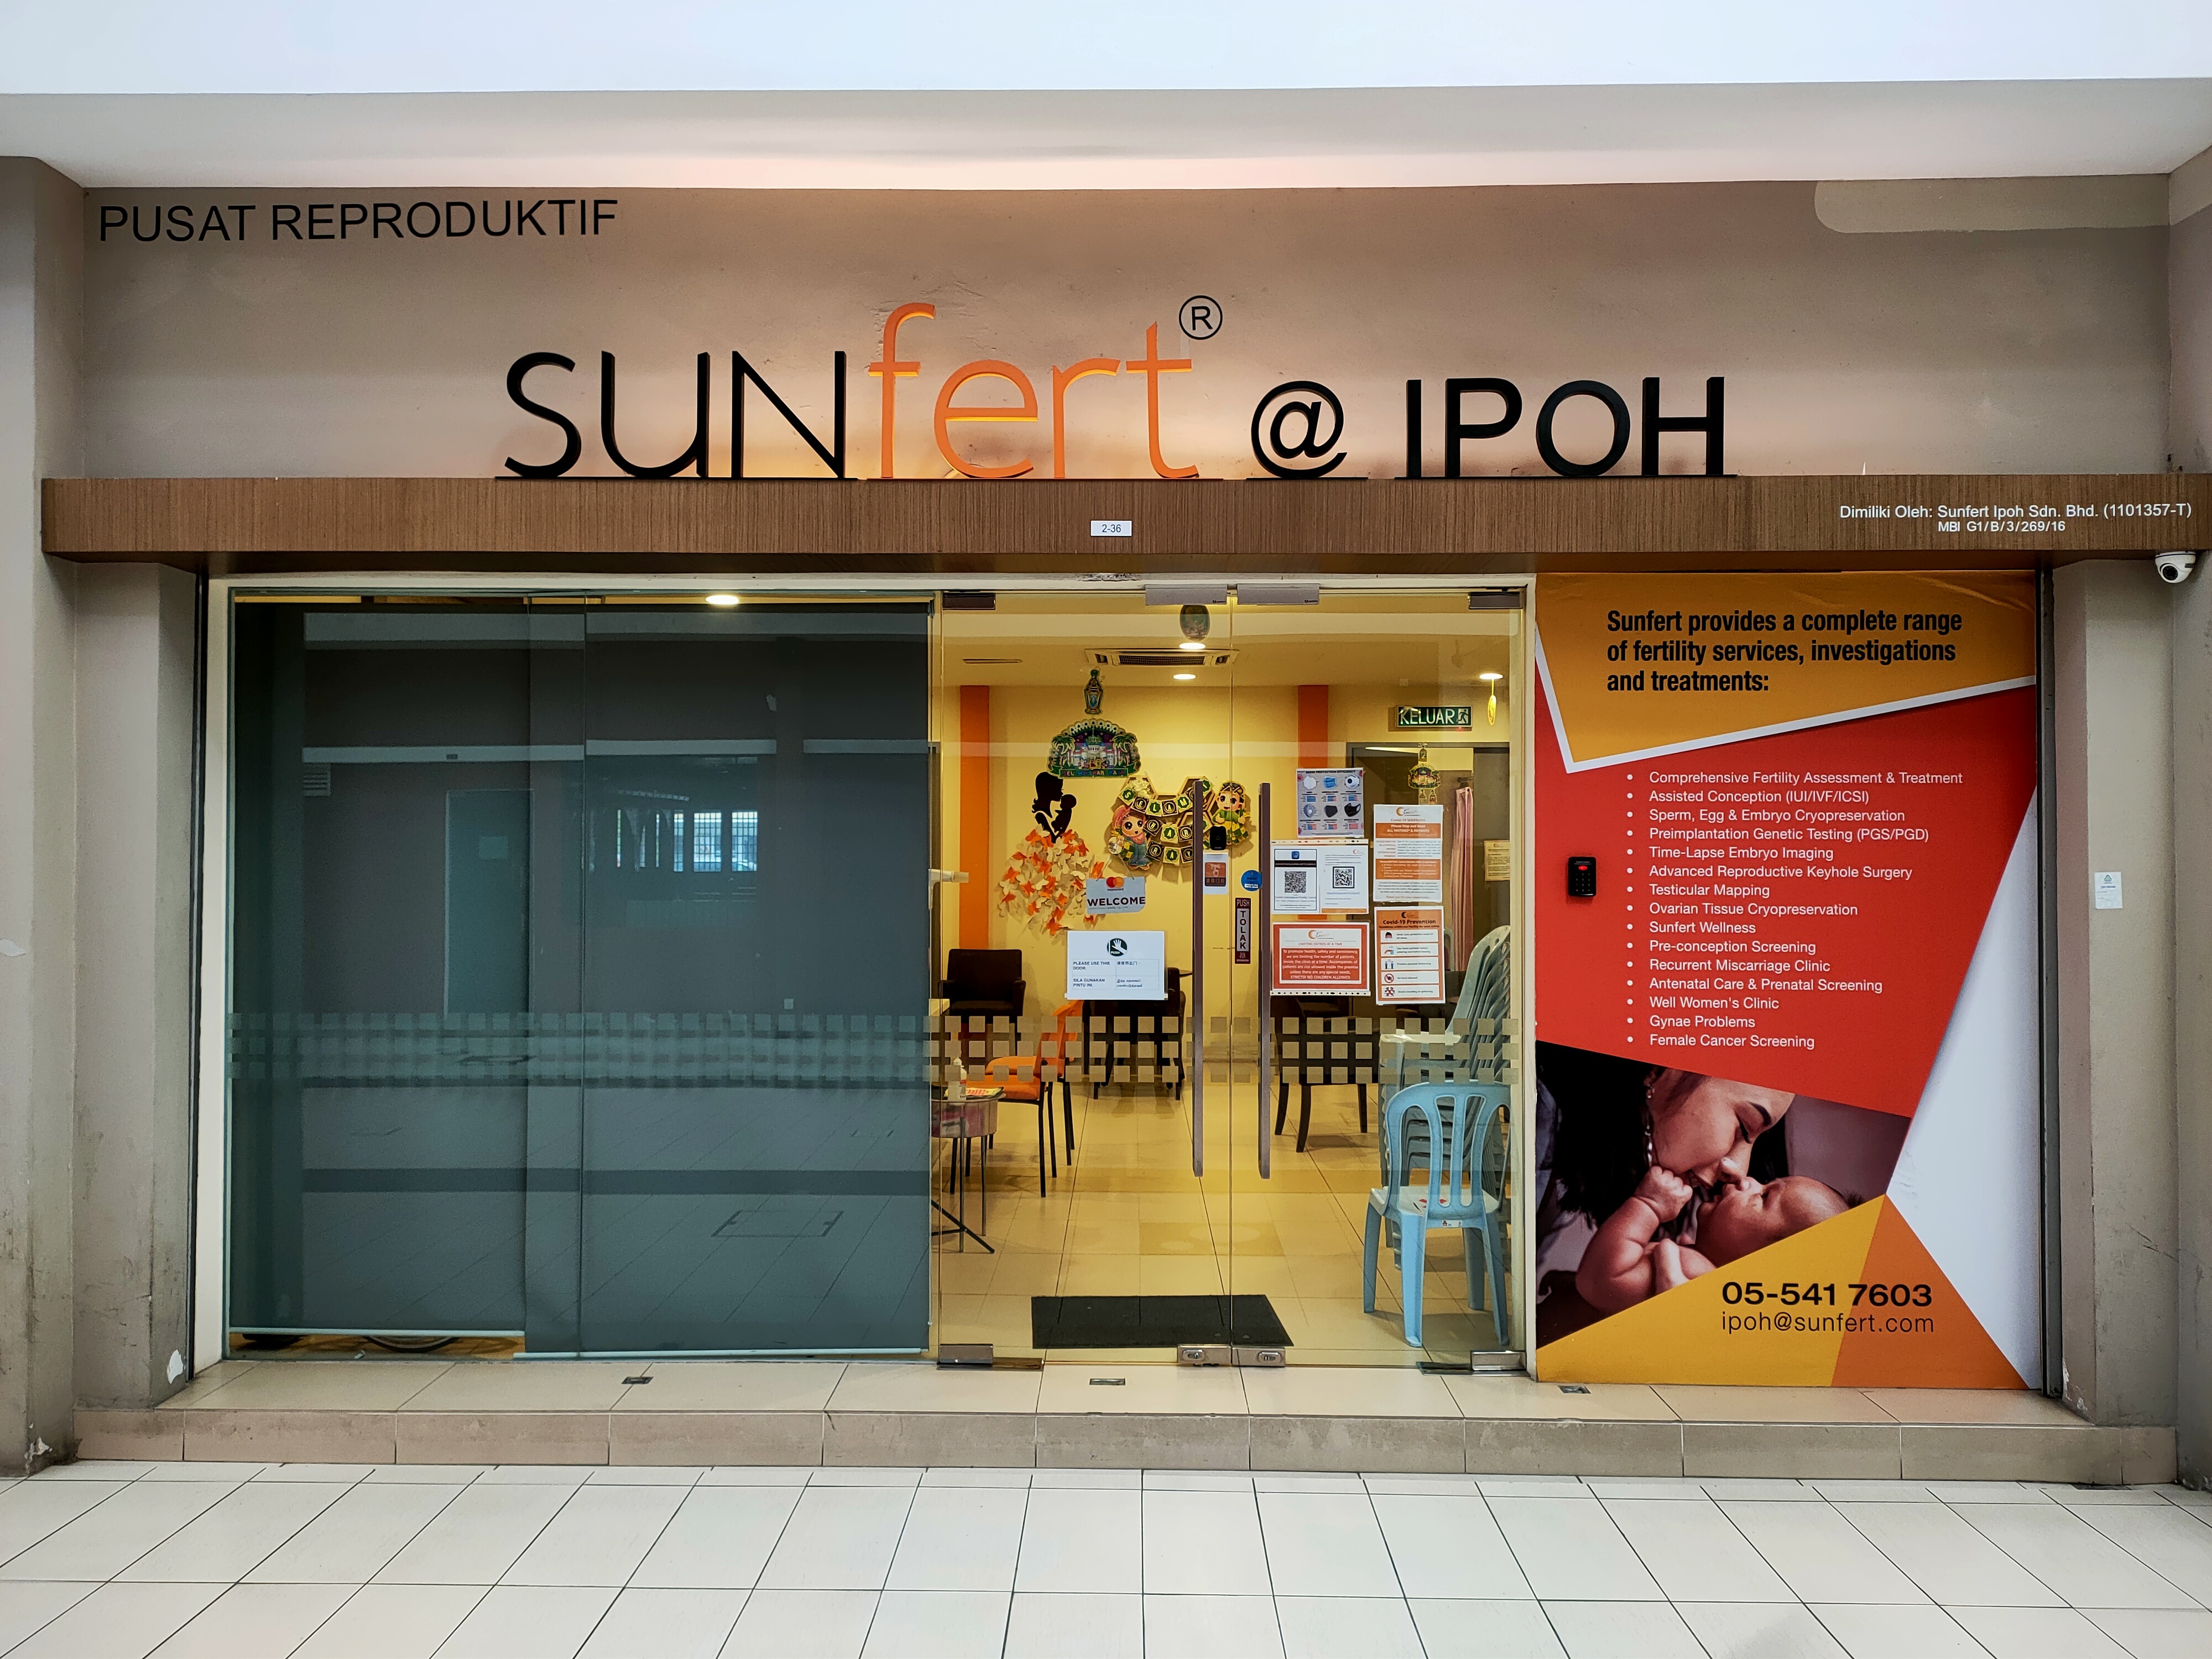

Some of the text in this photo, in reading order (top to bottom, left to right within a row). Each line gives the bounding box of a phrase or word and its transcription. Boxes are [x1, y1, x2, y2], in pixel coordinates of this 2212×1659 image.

[95, 199, 618, 242] PUSAT REPRODUKTIF
[504, 302, 1200, 478] SUNfert
[1251, 380, 1348, 478] @
[1406, 376, 1725, 477] IPOH
[1840, 502, 2192, 520] Dimiliki Oleh: Sunfert Ipoh Sdn. Bhd. (1101357-T)
[1102, 524, 1121, 533] 2-36
[1938, 520, 2065, 532] MBI G1/B/3/269/16
[1607, 609, 1963, 636] Sunfert provides a complete range
[1607, 639, 1956, 666] of fertility services, investigations
[1607, 670, 1768, 691] and treatments:
[1400, 708, 1455, 724] KELUAR
[1650, 771, 1963, 786] Comprehensive Fertility Assessment & Treatment
[1648, 790, 1869, 805] Assisted Conception (IUI/IVF/ICSI)
[1649, 808, 1905, 824] Sperm, Egg & Embryo Cryopreservation
[1650, 827, 1929, 843] Preimplantation Genetic Testing (PGS/PGD)
[1648, 846, 1833, 862] Time-Lapse Embryo Imaging
[1649, 865, 1913, 880] Advanced Reproductive Keyhole Surgery
[1648, 884, 1770, 899] Testicular Mapping
[1087, 896, 1146, 906] WELCOME
[1650, 902, 1858, 917] Ovarian Tissue Cryopreservation
[1649, 921, 1756, 933] Sunfert Wellness
[1650, 940, 1816, 956] Pre-conception Screening
[1650, 958, 1830, 974] Recurrent Miscarriage Clinic
[1649, 977, 1882, 994] Antenatal Care & Prenatal Screening
[1649, 996, 1779, 1009] Well Women's Clinic
[1650, 1015, 1755, 1030] Gynae Problems
[1650, 1034, 1814, 1050] Female Cancer Screening
[1722, 1281, 1932, 1307] 05-541 7603
[1723, 1311, 1934, 1334] ipoh@sunfert.com
